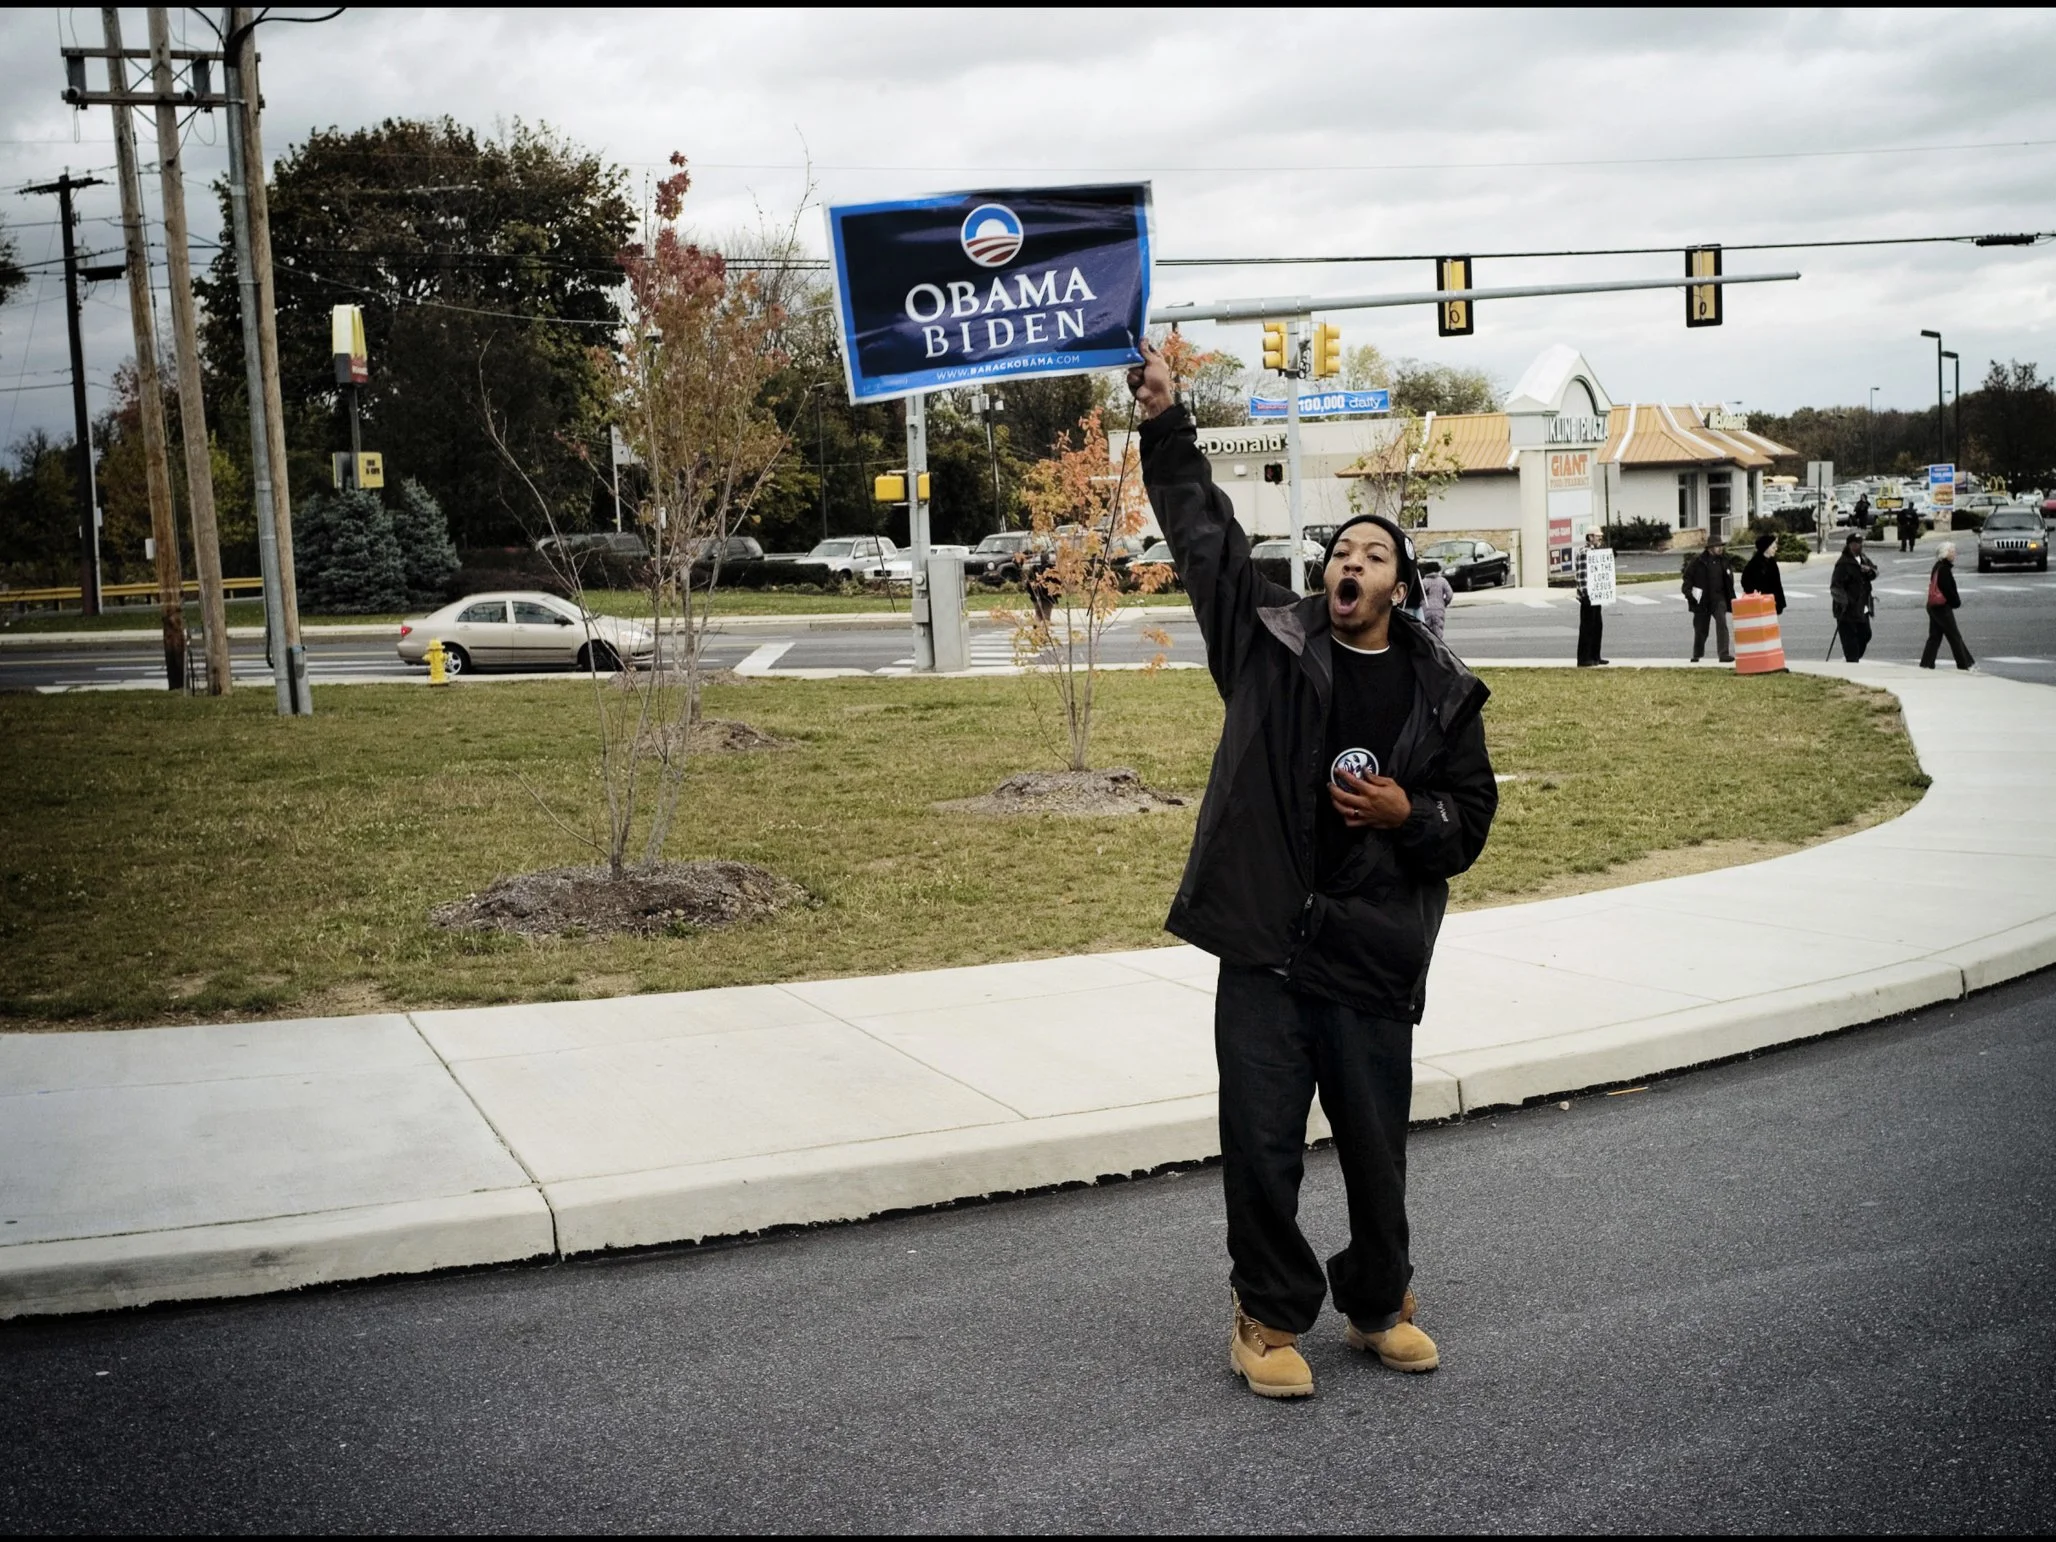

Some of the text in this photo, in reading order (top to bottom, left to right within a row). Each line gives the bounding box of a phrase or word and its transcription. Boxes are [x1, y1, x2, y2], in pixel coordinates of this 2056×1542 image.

[905, 266, 1097, 323] OBAMA
[922, 308, 1085, 359] BIDEN
[936, 355, 1080, 381] WWW.BARACKOBAMA.COM
[1349, 396, 1382, 409] daily
[1549, 416, 1609, 443] KLINE PLAZA
[1551, 454, 1588, 476] GIANT
[1588, 554, 1613, 564] BELIEVE
[1590, 563, 1612, 573] ON THE
[1594, 572, 1610, 582] LORD
[1592, 581, 1612, 591] JESUS
[1590, 591, 1613, 601] CHRIST
